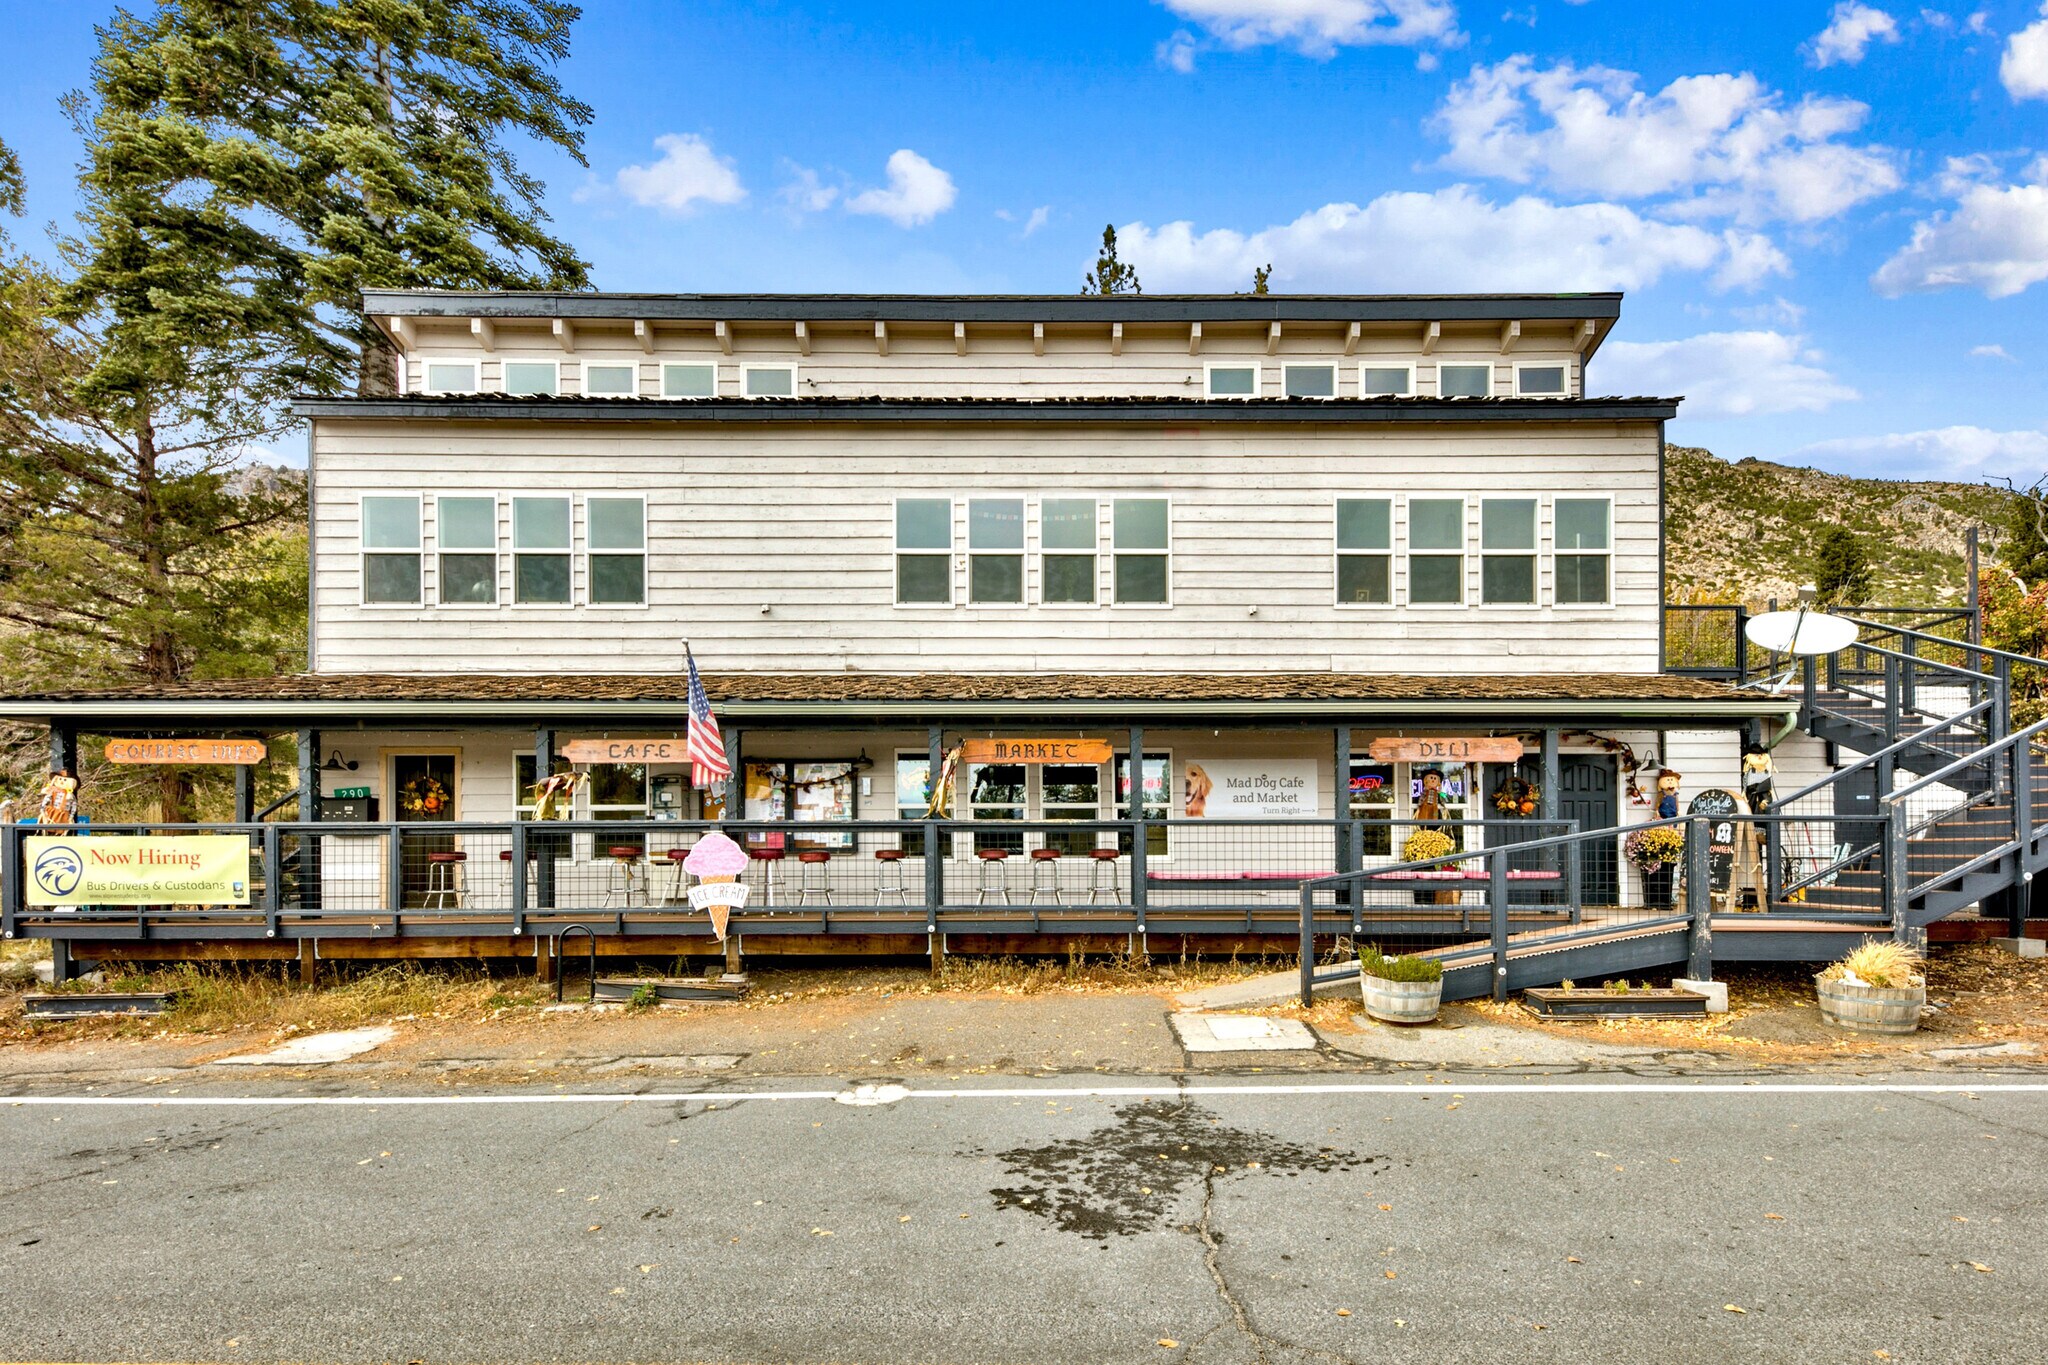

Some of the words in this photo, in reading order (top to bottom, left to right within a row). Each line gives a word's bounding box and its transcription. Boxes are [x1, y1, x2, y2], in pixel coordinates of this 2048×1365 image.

[112, 744, 200, 759] TOURIST
[211, 744, 258, 760] INFO
[608, 744, 671, 758] CAFE
[995, 743, 1078, 758] MARKET
[1419, 742, 1470, 757] DELI
[1226, 777, 1252, 788] Mad
[1254, 777, 1277, 791] Dog
[1279, 776, 1304, 788] Cafe
[1348, 777, 1382, 789] OPEN
[341, 788, 364, 798] 290
[1232, 792, 1254, 803] and
[1257, 792, 1298, 803] Market
[1281, 806, 1301, 815] Right
[90, 849, 132, 865] Now
[138, 848, 201, 870] Hiring
[87, 881, 107, 891] Bus
[110, 881, 149, 891] Drivers
[152, 881, 161, 891] &
[692, 888, 710, 904] ICE
[712, 885, 745, 900] CREAM
